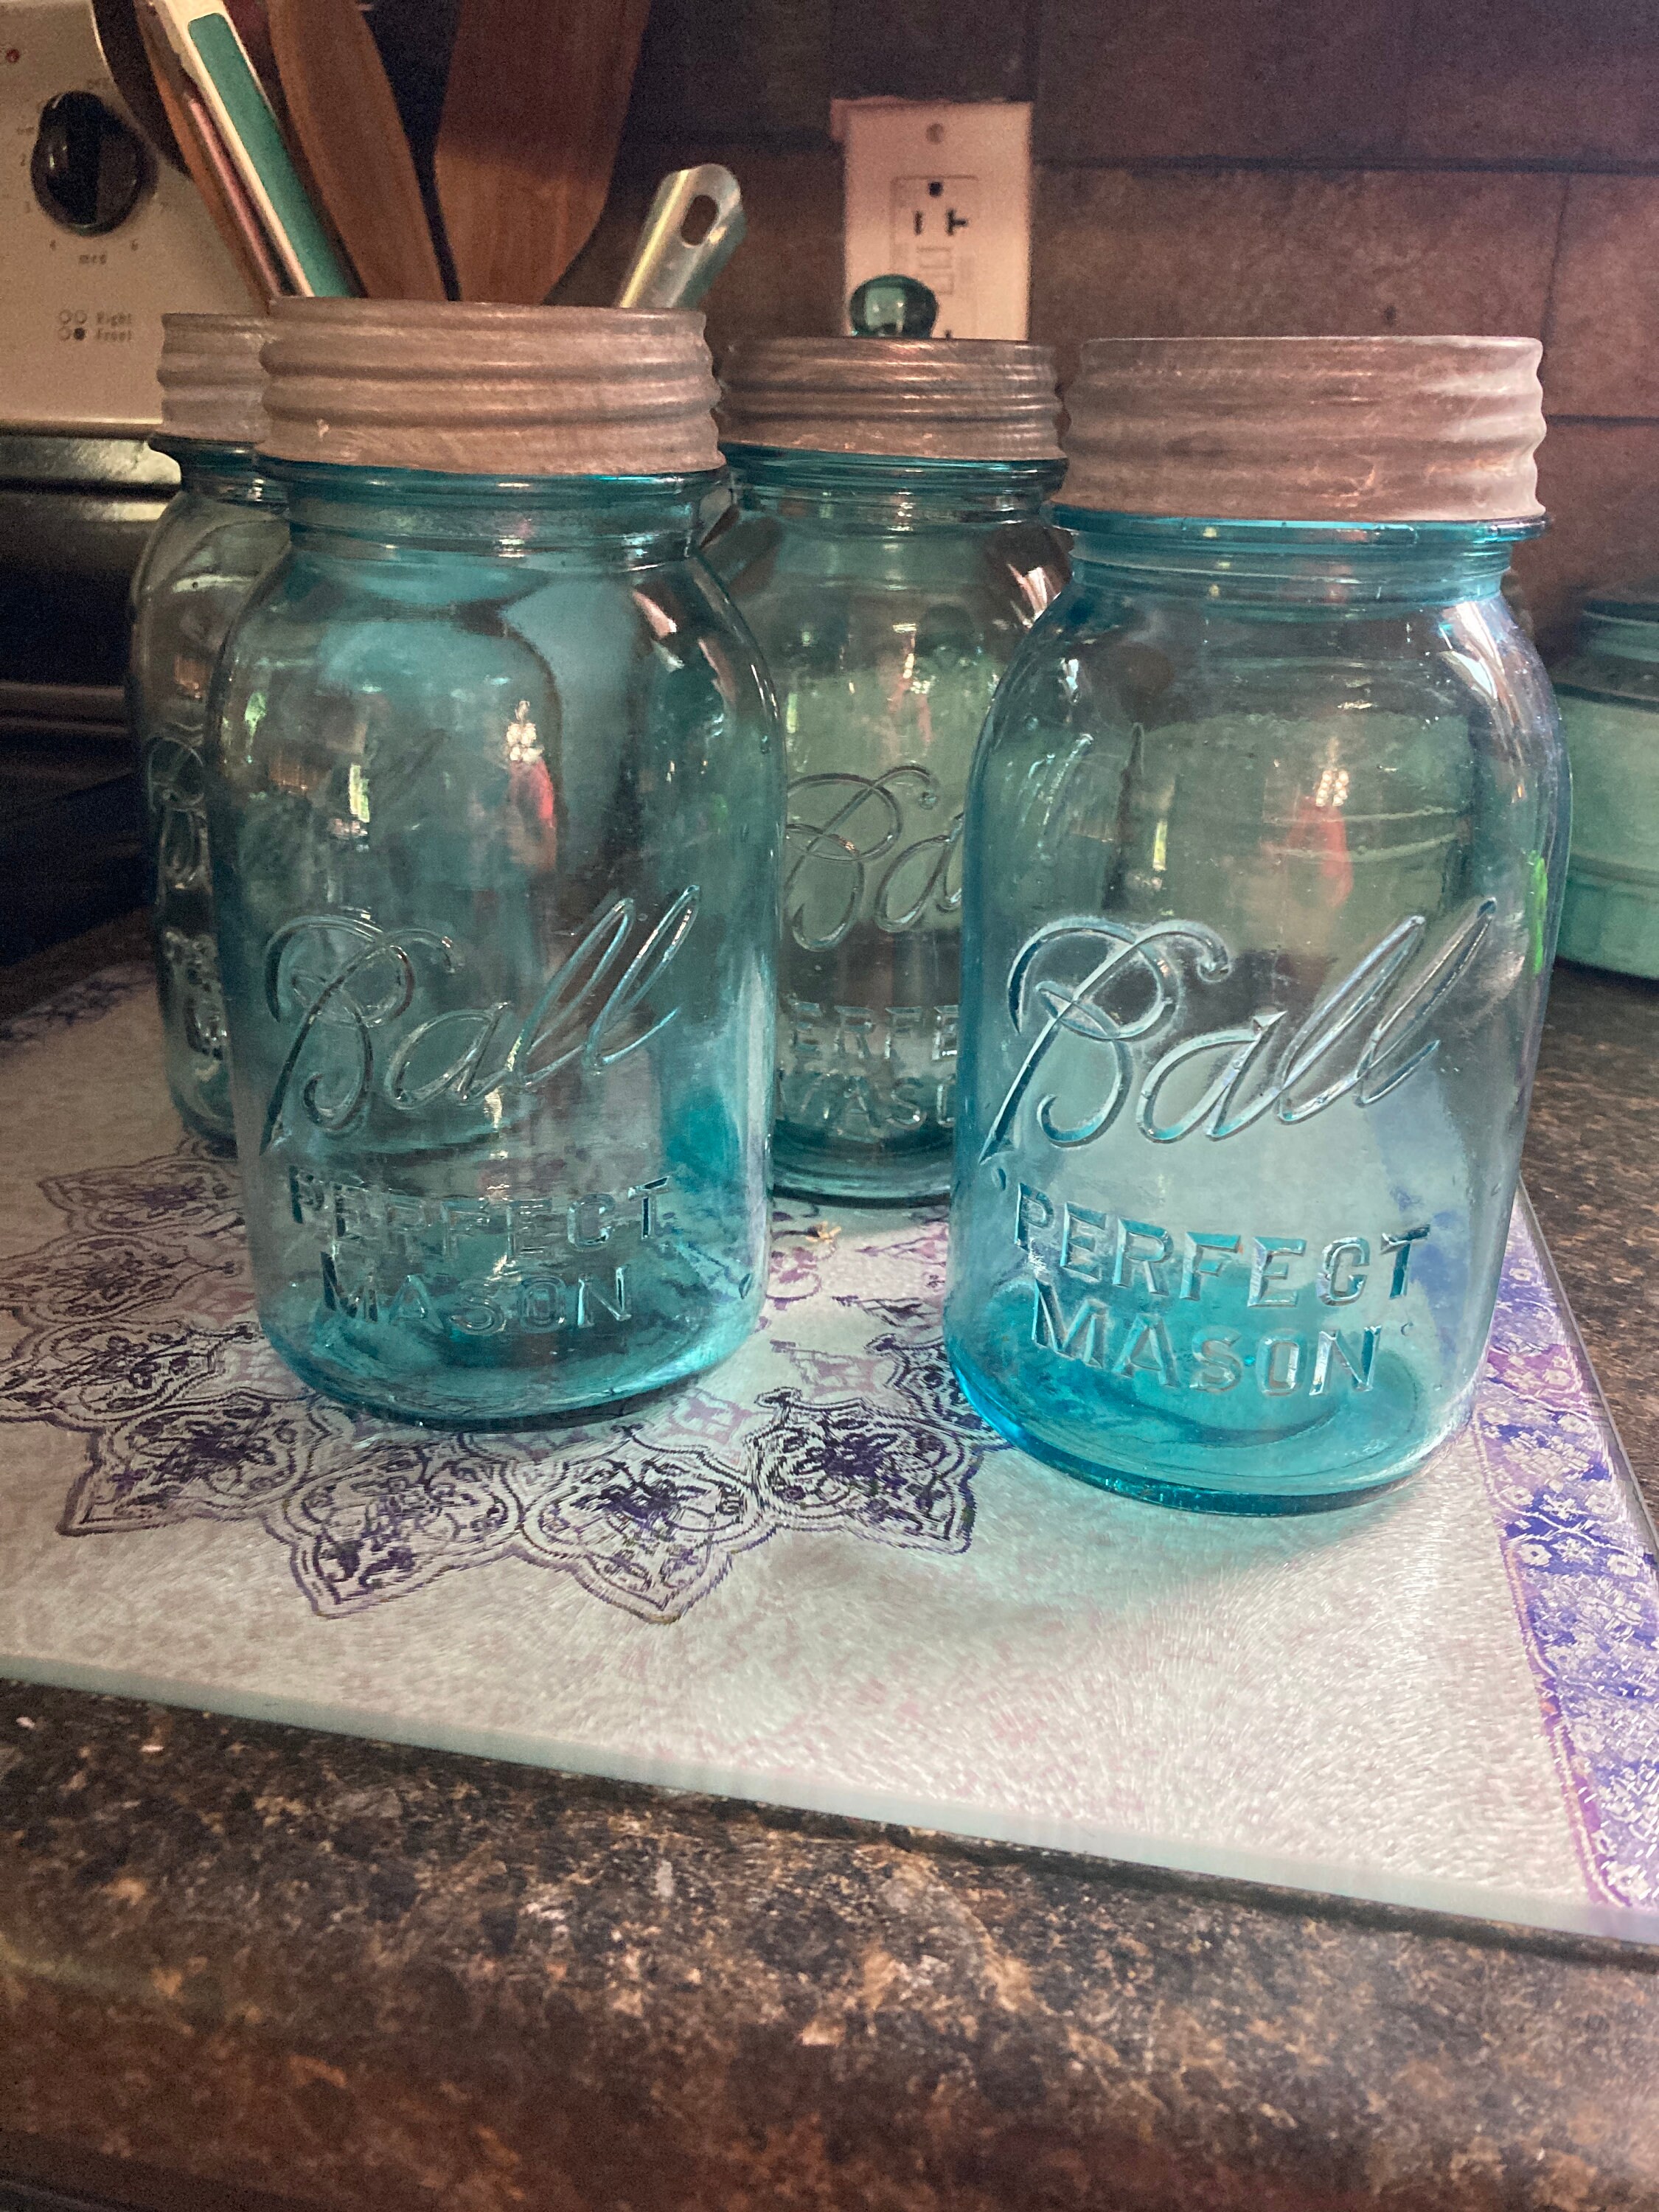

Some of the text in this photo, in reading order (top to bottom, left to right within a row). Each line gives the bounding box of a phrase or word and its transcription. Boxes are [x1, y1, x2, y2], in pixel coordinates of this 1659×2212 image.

[258, 885, 699, 1155] Ball
[979, 896, 1498, 1165] Ball
[288, 1165, 671, 1256] PERFECT
[1014, 1183, 1432, 1309] PERFECT
[320, 1251, 634, 1335] MASON
[1029, 1278, 1383, 1397] MASON
